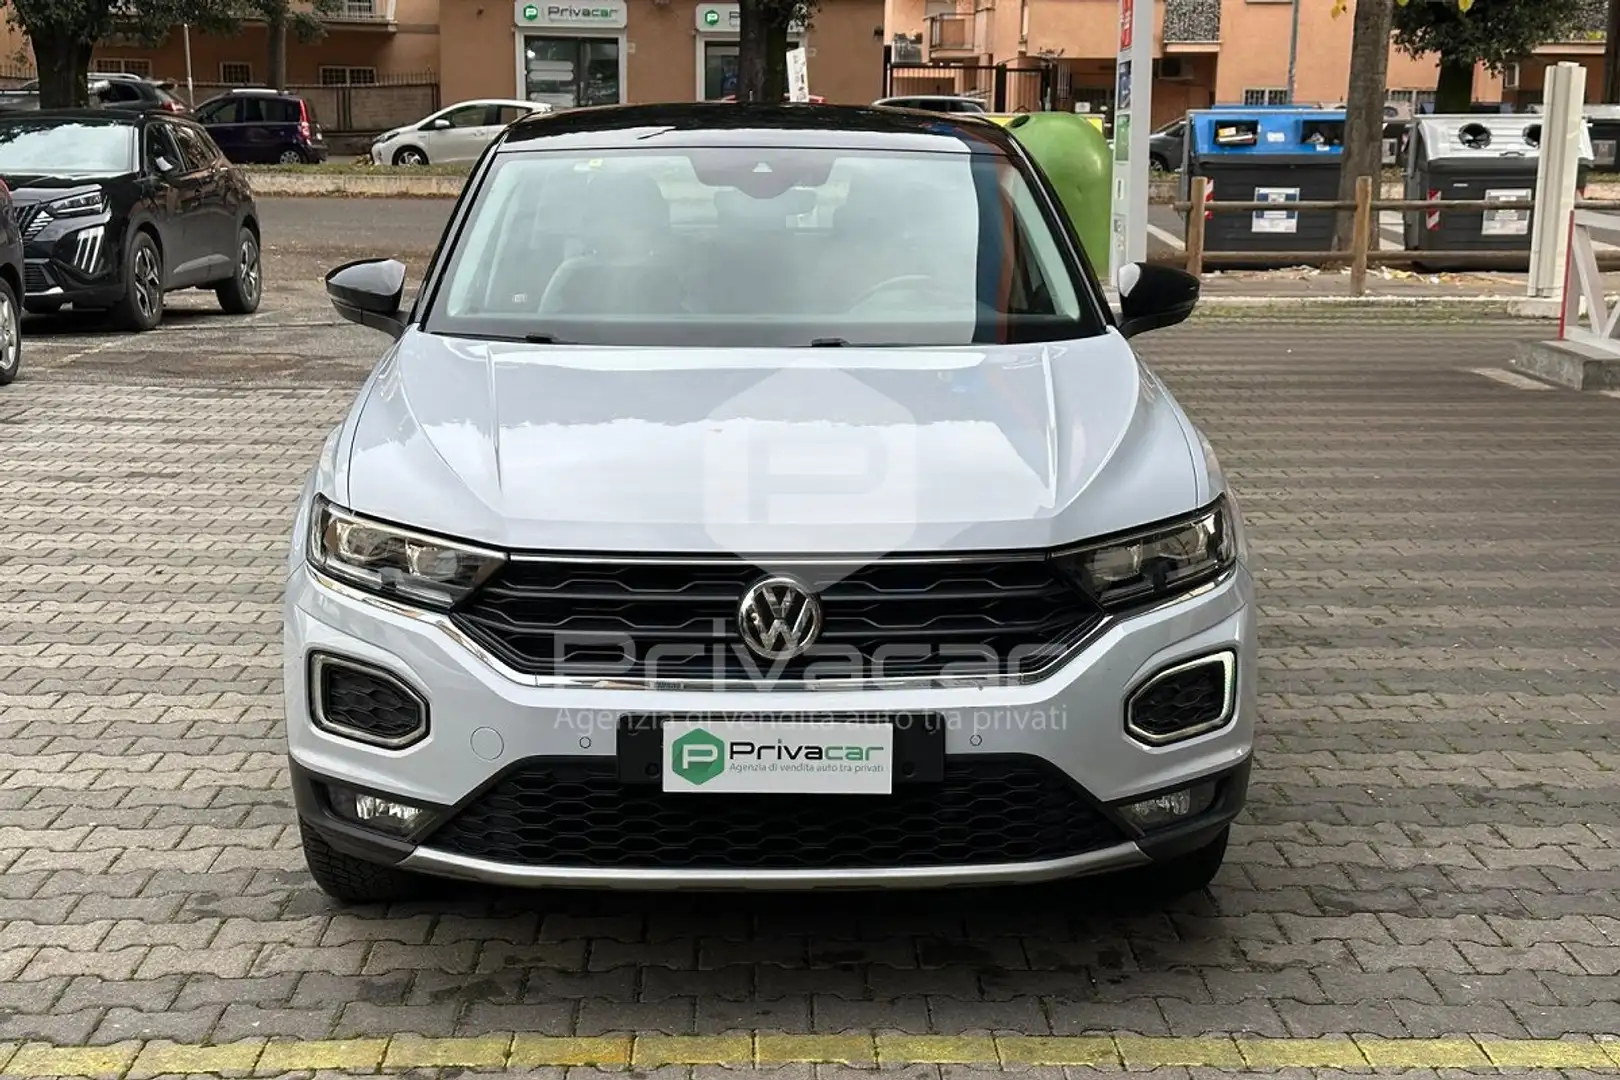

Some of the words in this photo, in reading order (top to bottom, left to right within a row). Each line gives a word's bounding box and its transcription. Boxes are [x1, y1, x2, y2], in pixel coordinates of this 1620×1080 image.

[548, 5, 620, 17] Privacar
[729, 738, 884, 761] Privacar
[729, 763, 767, 774] Agenzia
[769, 763, 778, 772] di
[780, 763, 814, 772] vendita
[816, 764, 838, 772] auto
[840, 764, 852, 772] tra
[854, 763, 884, 774] privati
